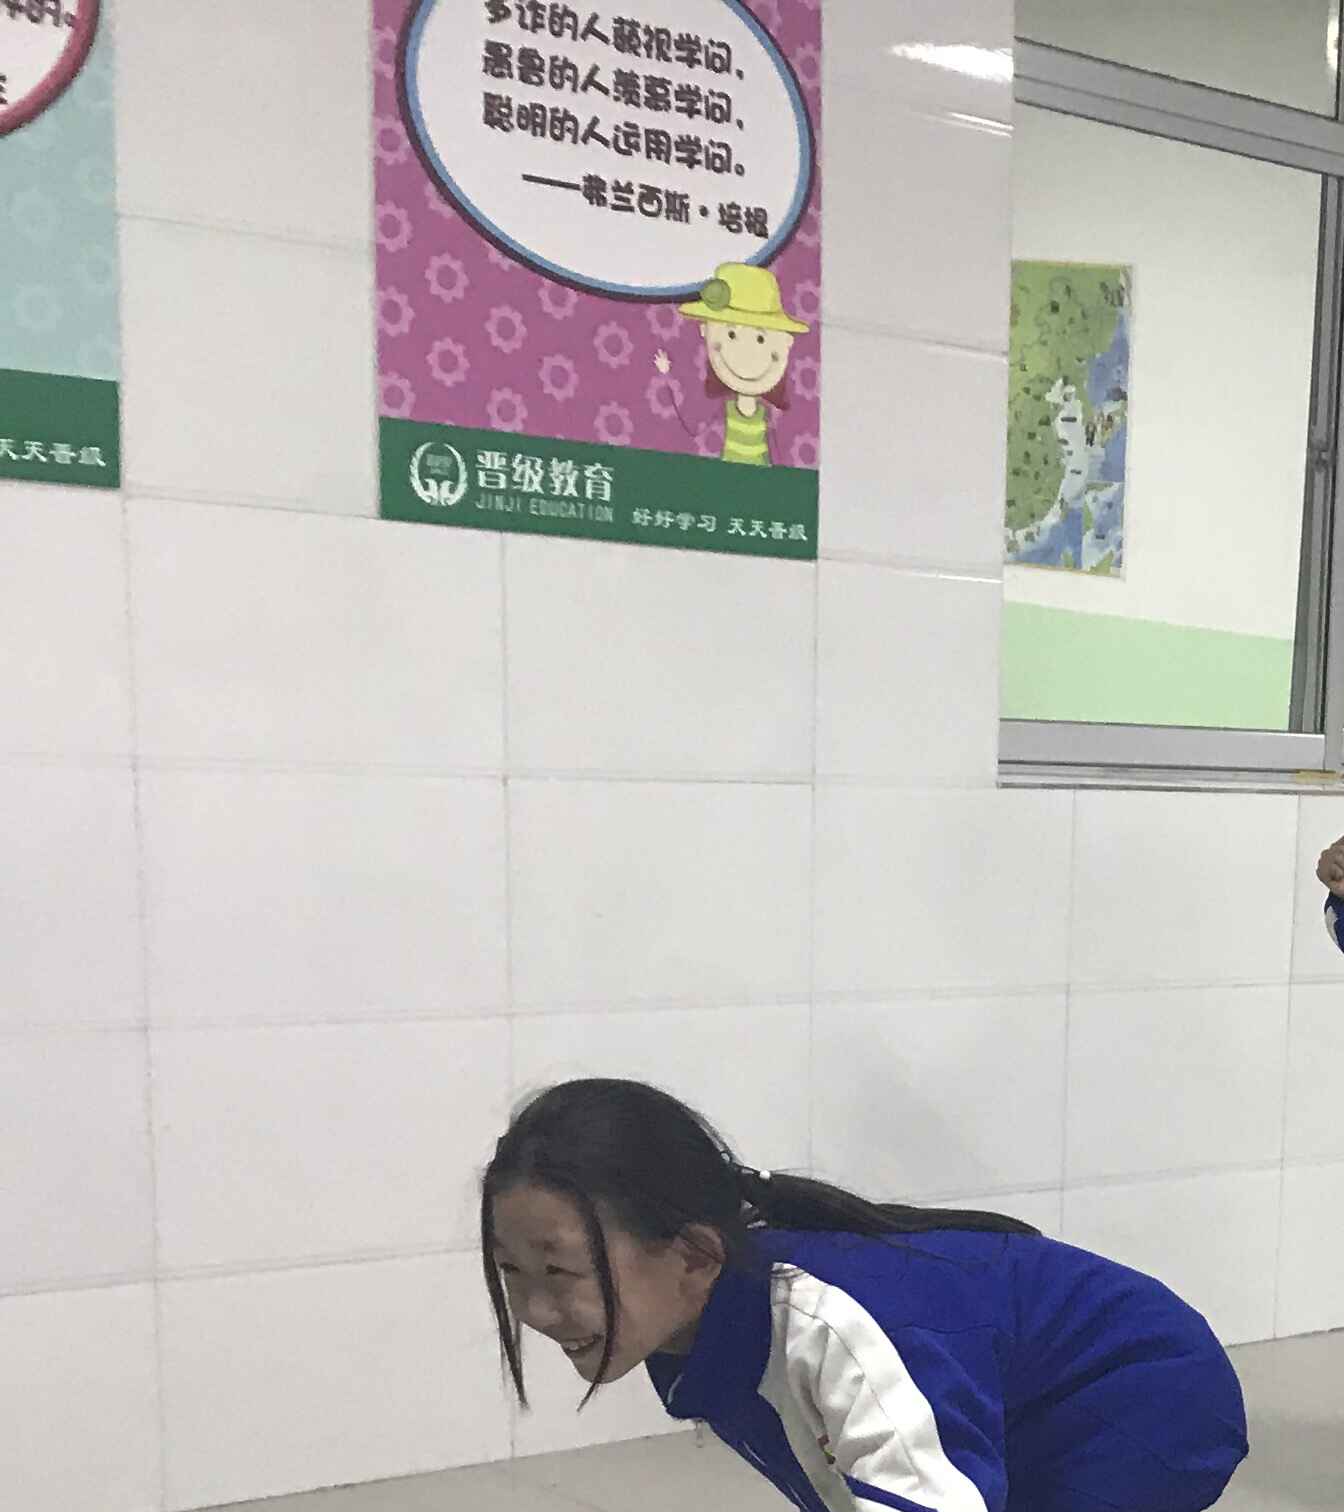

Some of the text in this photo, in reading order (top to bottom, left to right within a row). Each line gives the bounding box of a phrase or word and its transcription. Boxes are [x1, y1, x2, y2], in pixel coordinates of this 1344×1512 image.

[475, 449, 615, 502] 晋级教育
[475, 494, 614, 523] JINJI EDUCATION
[632, 507, 808, 541] 好好学习 天天晋级
